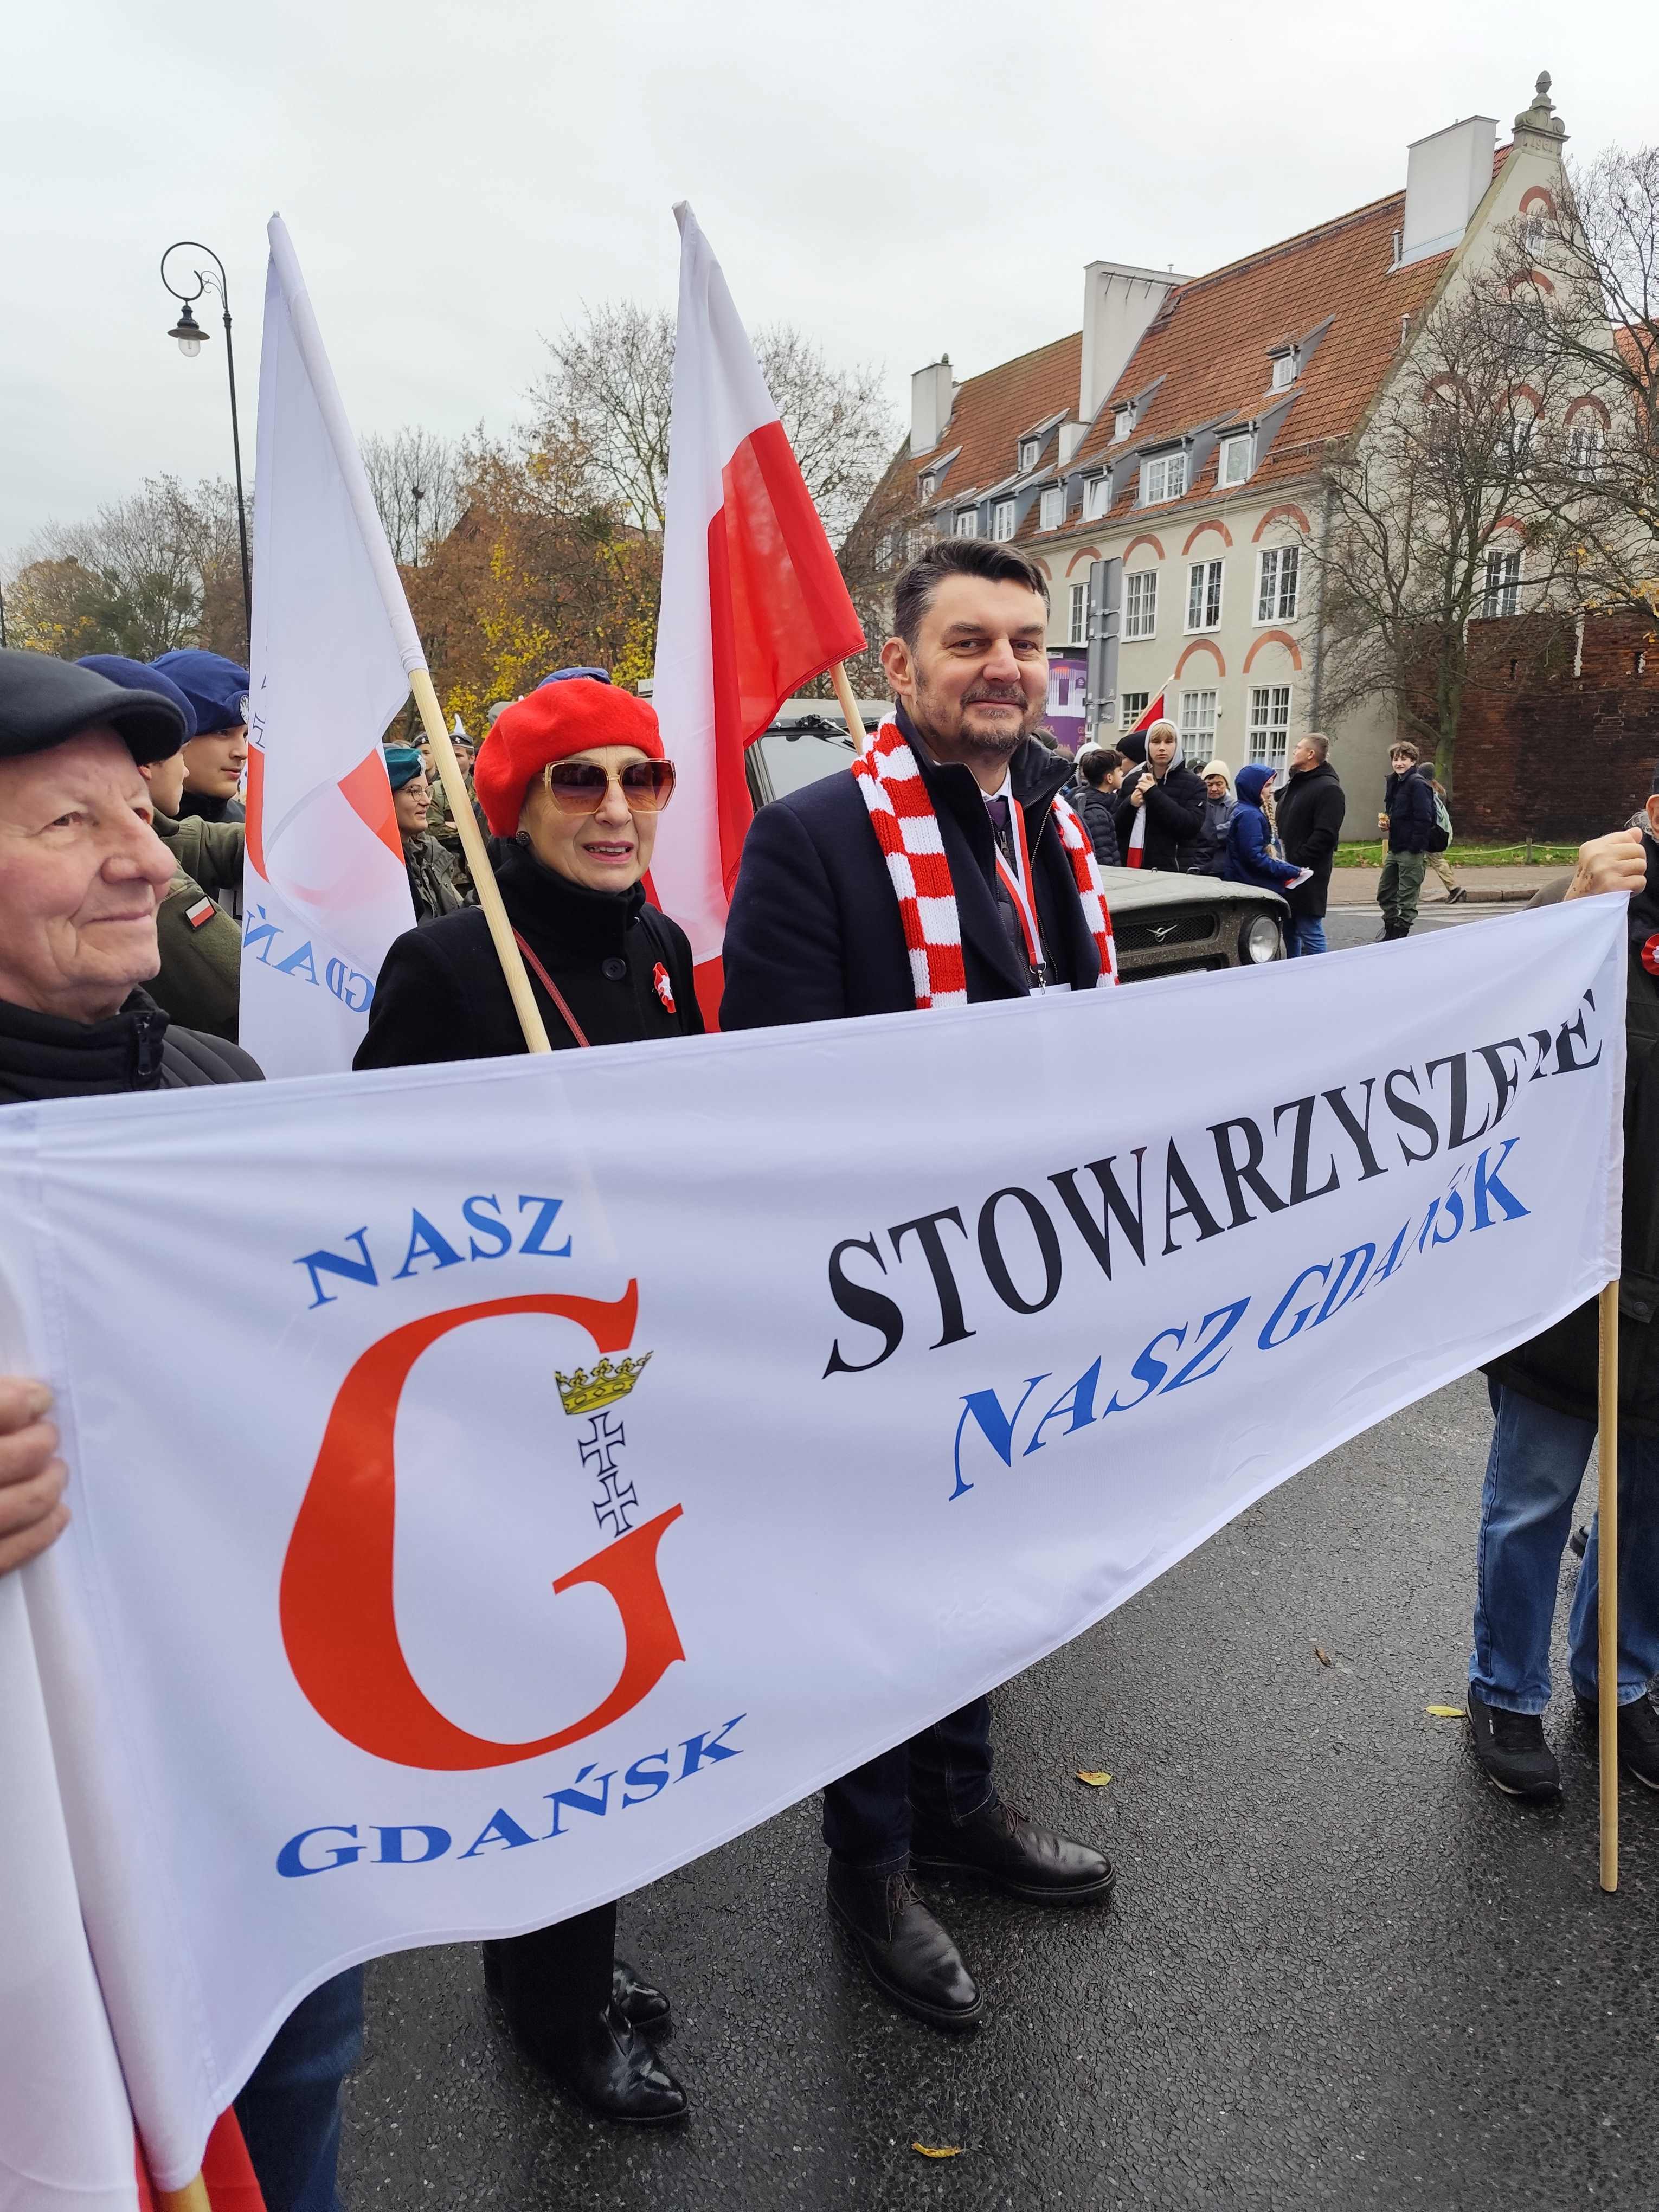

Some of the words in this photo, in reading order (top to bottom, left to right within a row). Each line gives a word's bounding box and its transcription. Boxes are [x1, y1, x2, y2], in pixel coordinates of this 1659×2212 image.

[293, 1194, 573, 1310] NASZ
[949, 1296, 1251, 1502] NASZ
[275, 1713, 747, 1879] GDAŃSK
